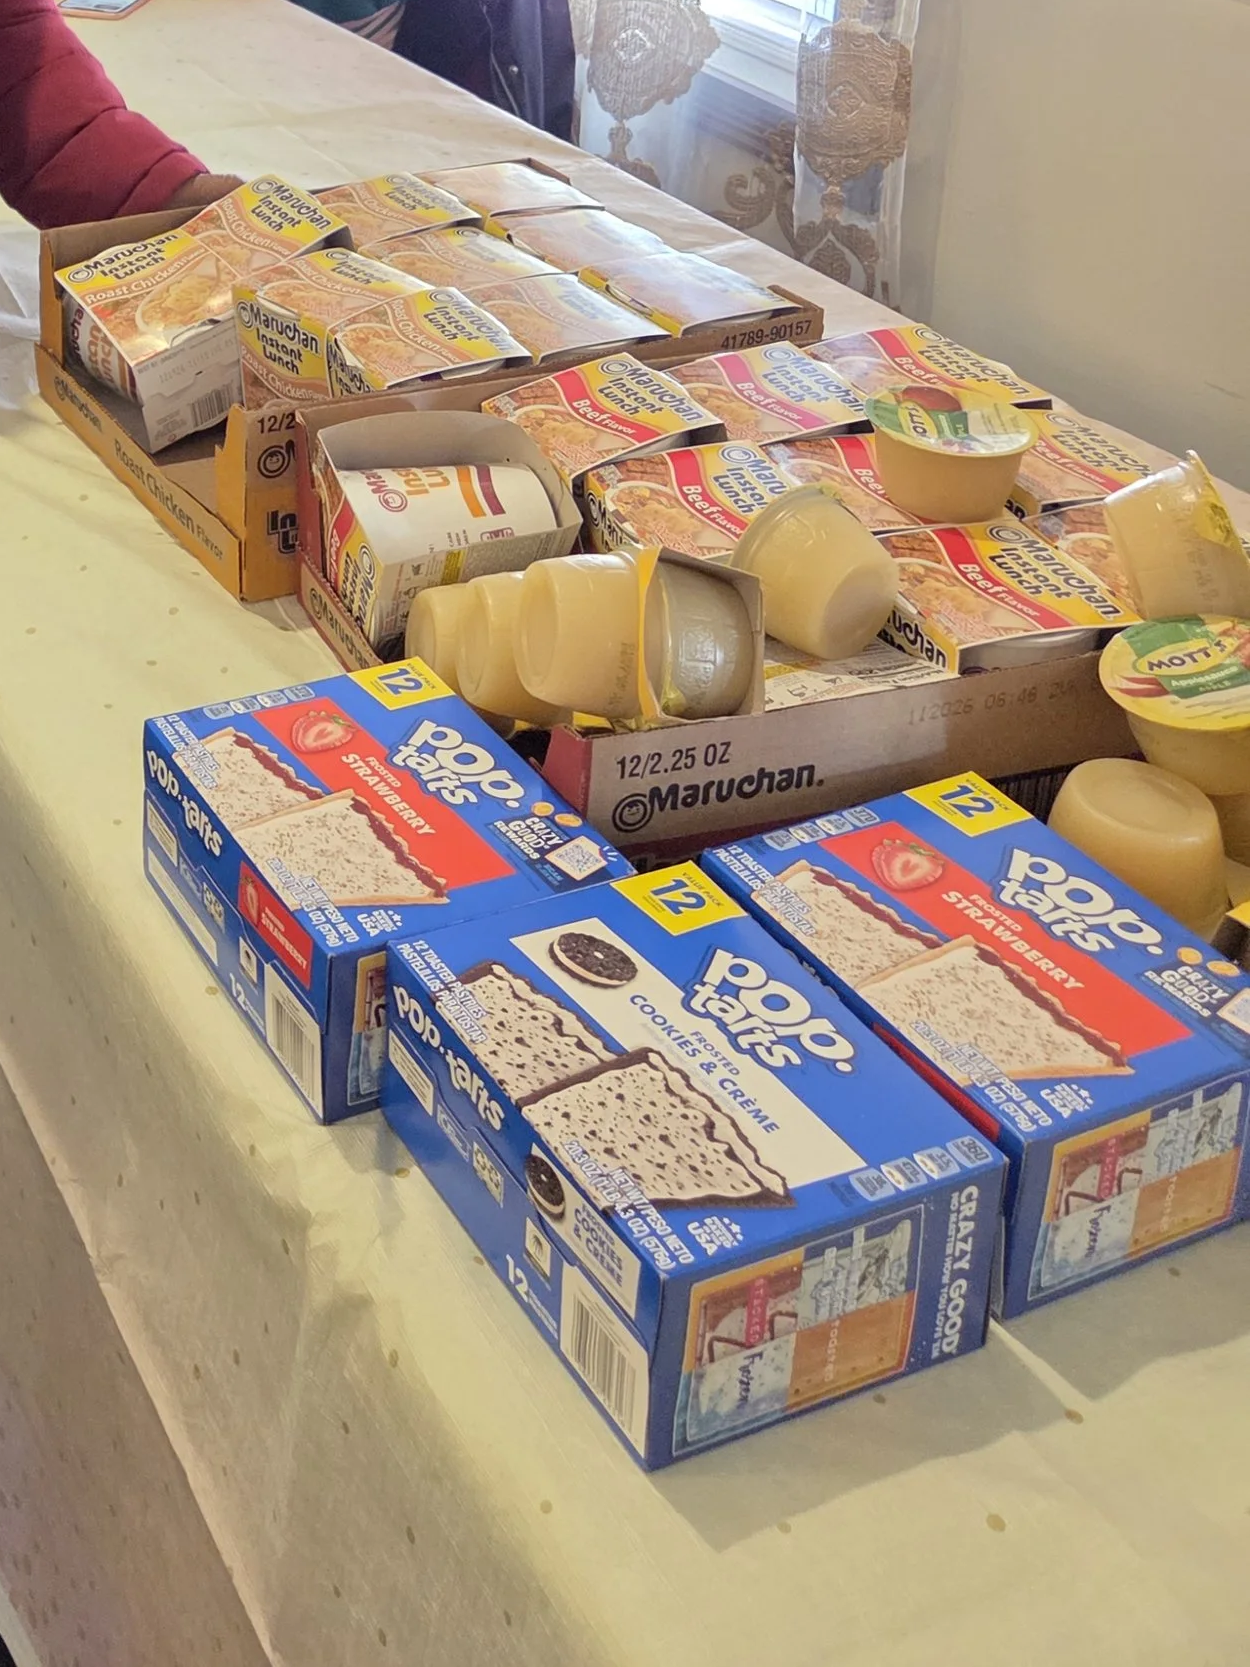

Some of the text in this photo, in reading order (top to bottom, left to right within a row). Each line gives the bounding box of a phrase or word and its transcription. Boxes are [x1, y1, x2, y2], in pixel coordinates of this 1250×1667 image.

[221, 198, 238, 226] Roast
[233, 218, 273, 248] Chicken
[250, 205, 284, 232] Lunch
[258, 195, 302, 228] Instant
[272, 184, 331, 230] Maruchan
[85, 232, 181, 271] Maruchan
[100, 246, 166, 277] Instant
[113, 255, 166, 280] Lunch
[85, 285, 129, 305] Roast
[131, 261, 183, 292] Chicken
[250, 302, 321, 355] Maruchan
[399, 318, 441, 353] Chicken
[423, 312, 458, 341] Lunch
[435, 305, 481, 342] Instant
[449, 294, 513, 351] Maruchan
[256, 327, 303, 363] Instant
[262, 345, 301, 376] Lunch
[927, 344, 990, 384] Instant
[772, 364, 826, 403] Instant
[789, 356, 865, 413] Maruchan
[894, 356, 934, 384] Beef
[918, 349, 966, 381] Lunch
[939, 335, 1031, 396] Maruchan
[267, 373, 311, 401] Chicken
[598, 386, 641, 416] Lunch
[608, 377, 664, 415] Instant
[627, 366, 704, 423] Maruchan
[736, 382, 804, 422] Beef Flavor
[761, 371, 806, 403] Lunch
[572, 398, 638, 435] Beef Flavor
[1052, 434, 1106, 469] Lunch
[1060, 430, 1130, 473] Instant
[712, 474, 752, 514] Lunch
[747, 458, 788, 497] Maru
[114, 439, 224, 561] Roast Chicken Flavor
[682, 484, 720, 518] Beef
[957, 563, 1041, 618] Beef Flavor
[987, 554, 1045, 597] Lunch
[1000, 546, 1074, 599] Instant
[1018, 540, 1122, 620] Maruchan
[377, 667, 424, 695] 12
[364, 755, 403, 789] FROSTED
[616, 741, 731, 781] 12/2.25 OZ
[341, 752, 436, 836] STRAWBERRY
[939, 784, 995, 818] 12
[493, 820, 541, 861] REWARDS
[524, 816, 564, 847] CRAZY
[651, 878, 706, 915] 12
[681, 872, 724, 910] VALUE PACK
[712, 848, 816, 936] PASTELILLOS PARA TOSTAR
[727, 845, 812, 915] 12 TOASTER PASTRIES
[357, 913, 380, 937] USA
[968, 893, 1023, 932] FROSTED
[941, 890, 1085, 990] STRAWBERRY
[397, 943, 443, 992] PASTELILLOS
[436, 989, 461, 1016] PARA
[453, 1011, 488, 1045] TOSTAR
[413, 940, 488, 1020] 12 TOASTER PASTRIES
[1144, 970, 1212, 1018] REWARDS
[1177, 965, 1229, 1000] CRAZY
[630, 993, 702, 1059] COOKIES
[699, 1061, 719, 1076] &
[718, 1076, 780, 1134] CRÈME
[689, 1030, 740, 1077] FROSTED
[999, 1101, 1038, 1132] (576g)
[1020, 1098, 1053, 1126] NETO
[1040, 1088, 1073, 1119] USA
[960, 1137, 990, 1163] 360
[581, 1159, 600, 1179] OZ
[627, 1213, 651, 1238] OZ)
[639, 1233, 677, 1270] (576g)
[610, 1166, 637, 1190] NET
[663, 1232, 695, 1264] NETO
[574, 1209, 623, 1271] COOKIES
[688, 1220, 719, 1256] USA
[506, 1254, 530, 1303] 12
[942, 1185, 979, 1354] CRAZY GOOD
